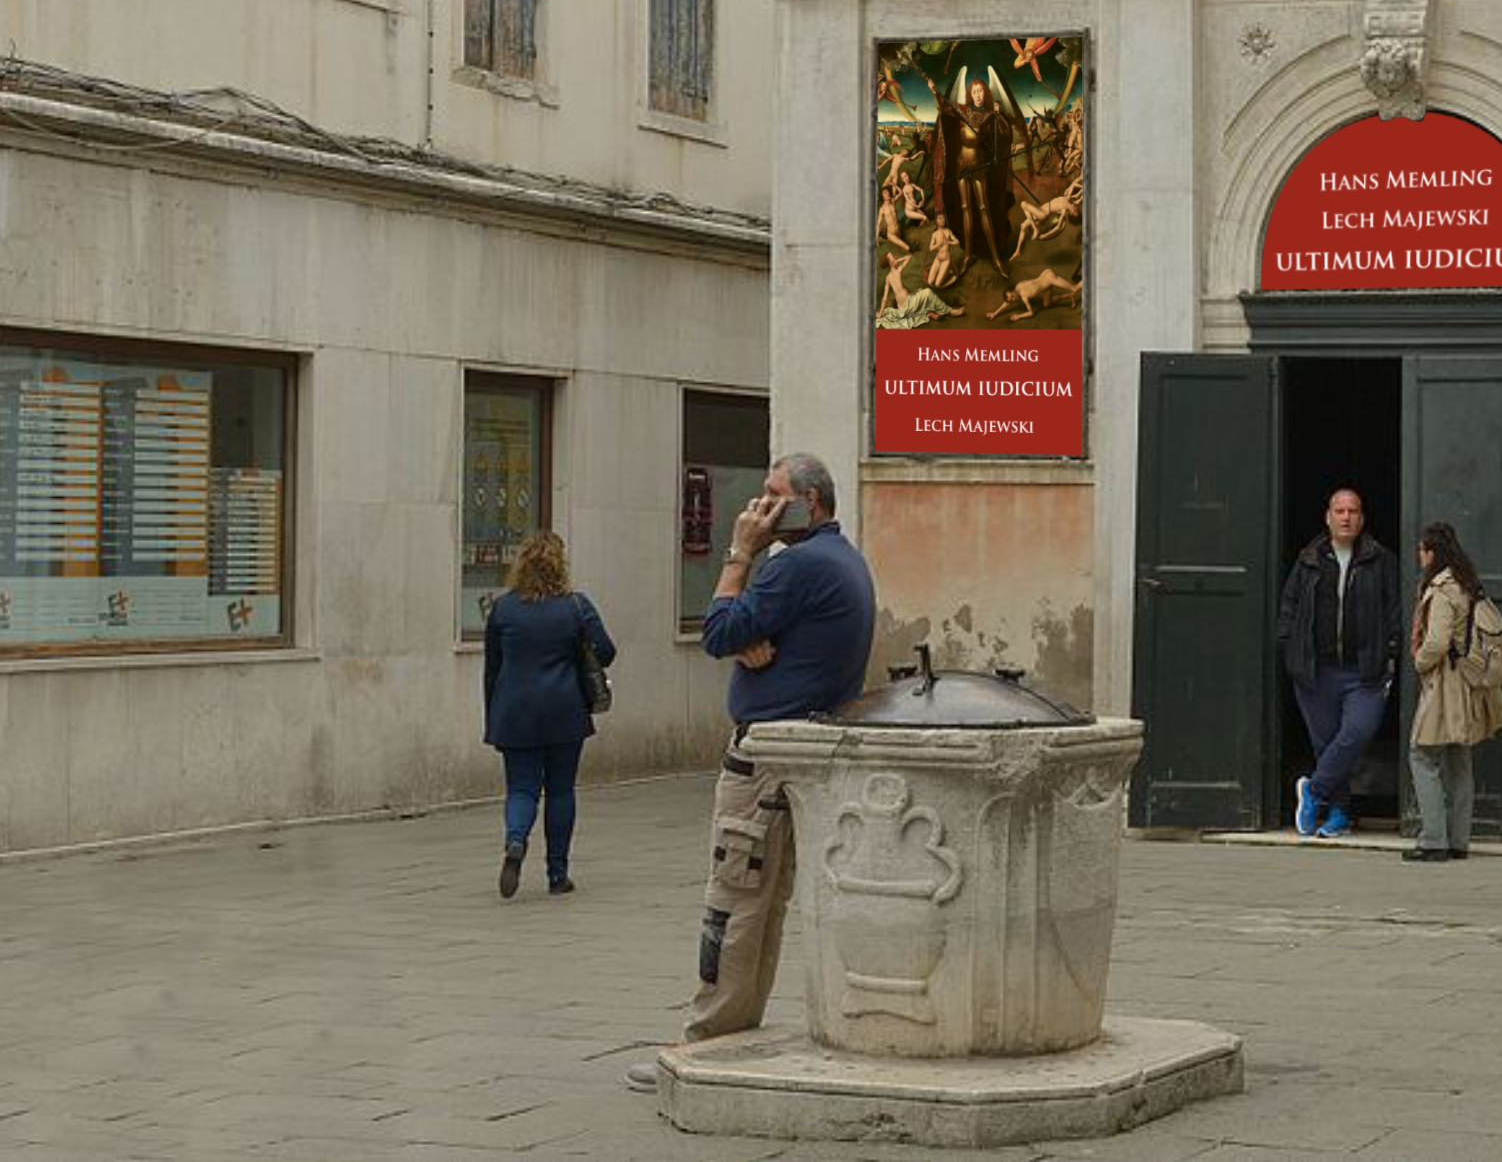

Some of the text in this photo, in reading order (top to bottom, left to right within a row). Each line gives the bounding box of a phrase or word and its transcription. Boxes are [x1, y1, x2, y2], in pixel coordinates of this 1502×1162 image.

[1320, 168, 1494, 192] HANS MEMLING
[1322, 208, 1490, 231] LECH MAJEWSKI
[1275, 250, 1396, 272] ULTIMUM
[917, 346, 1040, 364] HANS MEMLING
[884, 379, 1073, 398] ULTIMUM IUDICIUM
[914, 417, 1035, 437] LECH MAJEWSKI
